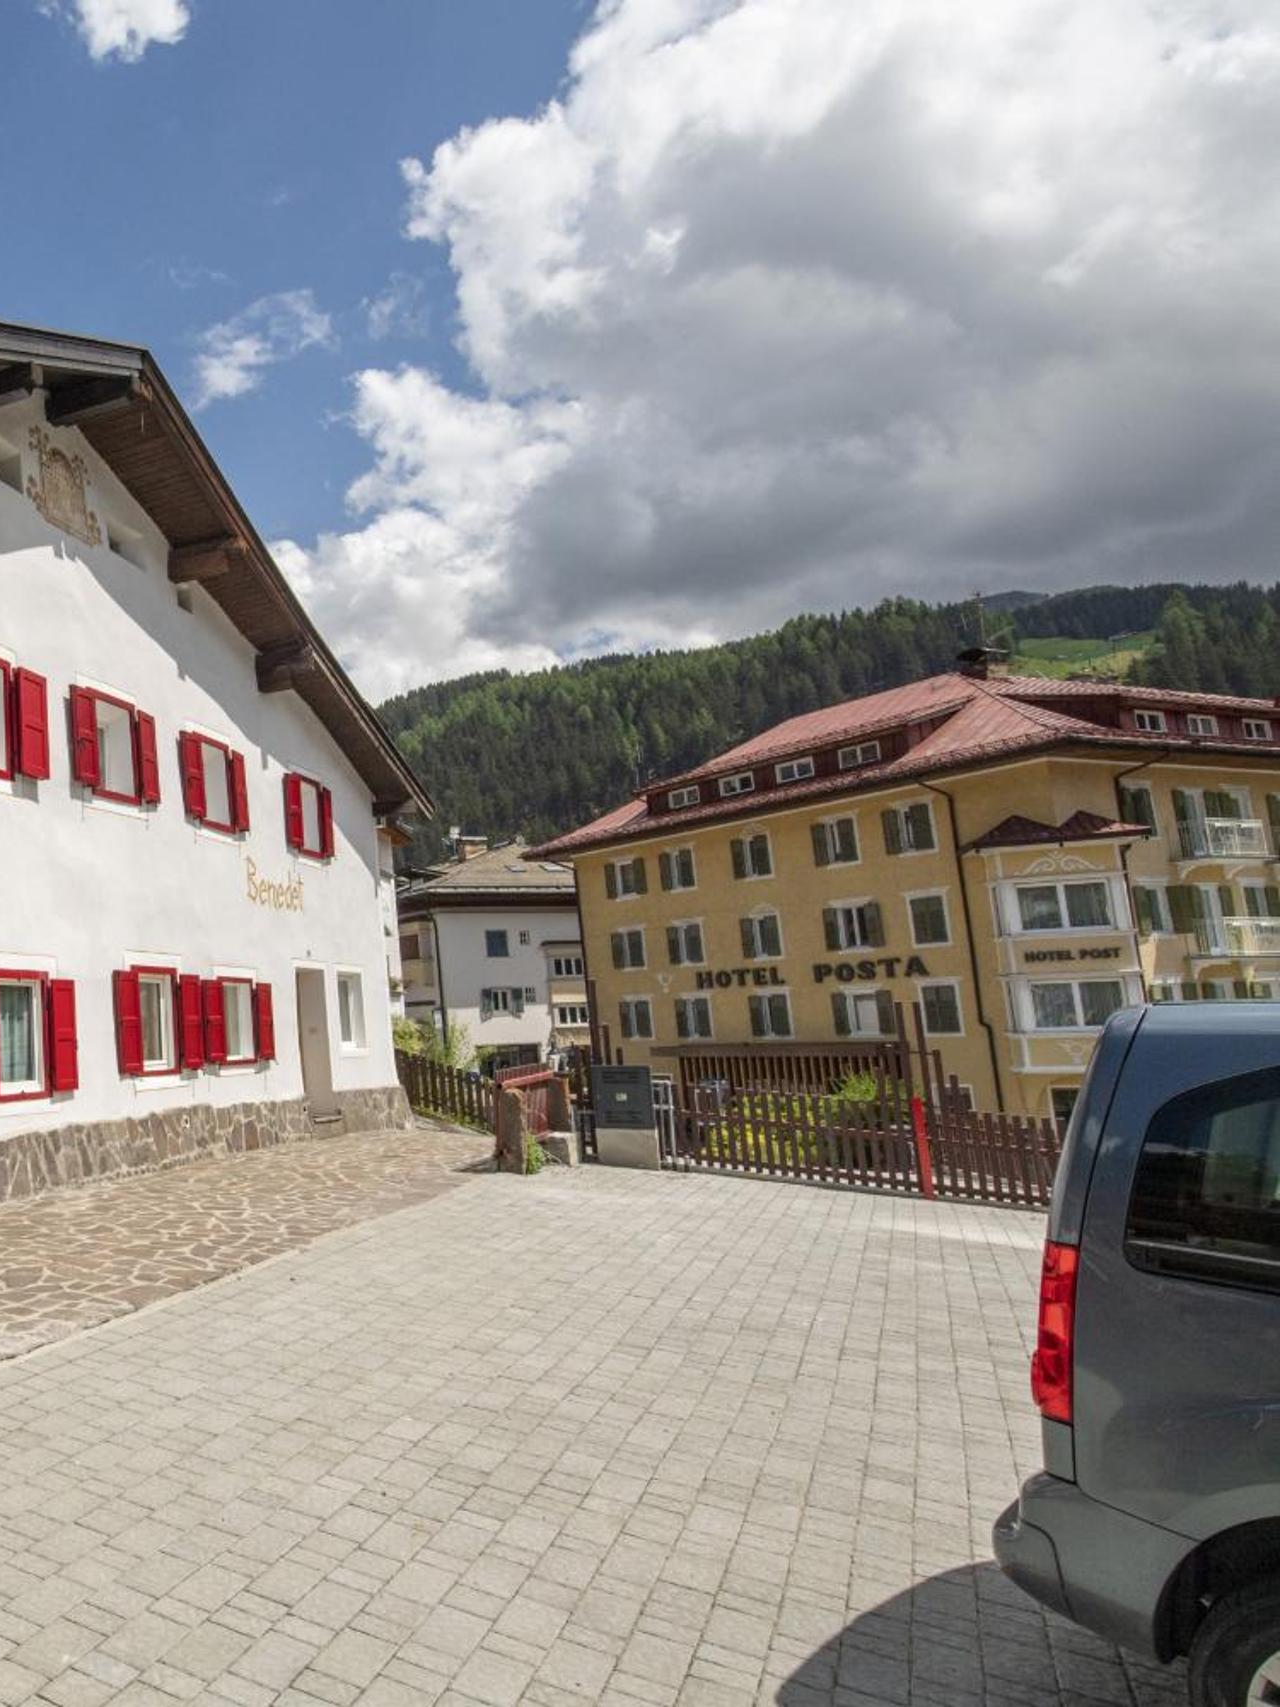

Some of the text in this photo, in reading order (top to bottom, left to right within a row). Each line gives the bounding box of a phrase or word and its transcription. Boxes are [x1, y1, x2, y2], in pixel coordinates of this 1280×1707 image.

[1023, 947, 1121, 963] HOTEL POST
[695, 955, 930, 989] HOTEL POSTA
